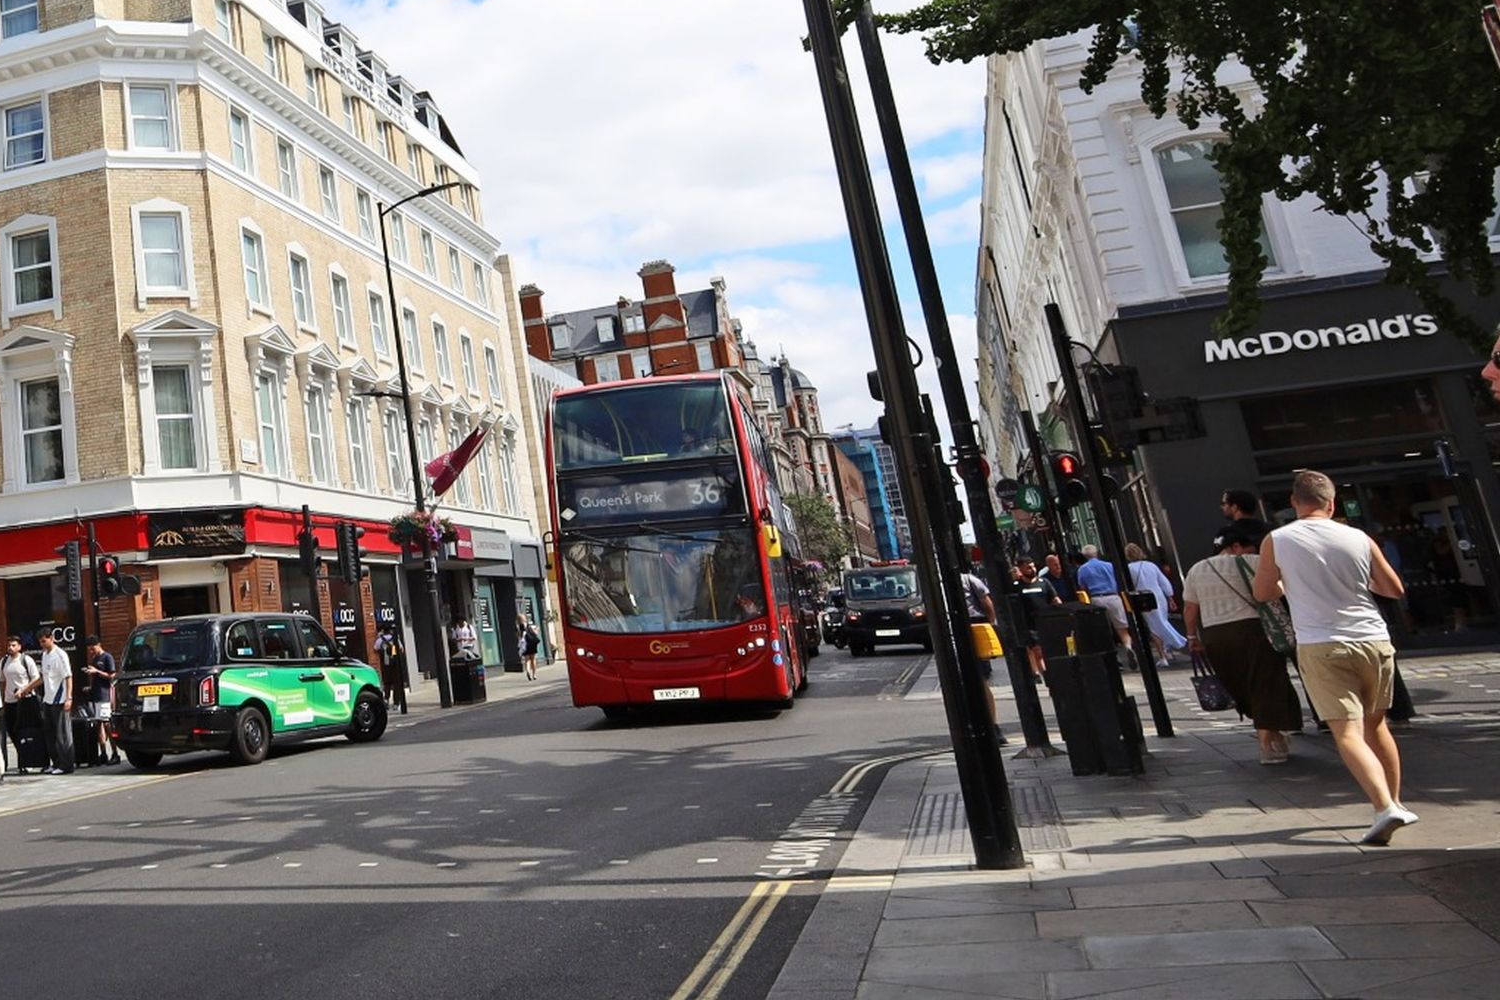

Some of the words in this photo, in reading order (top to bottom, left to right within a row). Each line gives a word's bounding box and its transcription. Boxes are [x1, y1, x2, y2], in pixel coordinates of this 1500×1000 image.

[1204, 313, 1438, 363] McDonald's
[580, 494, 631, 508] Queen's
[635, 492, 662, 505] Park
[688, 483, 719, 505] 36
[51, 626, 76, 644] CG
